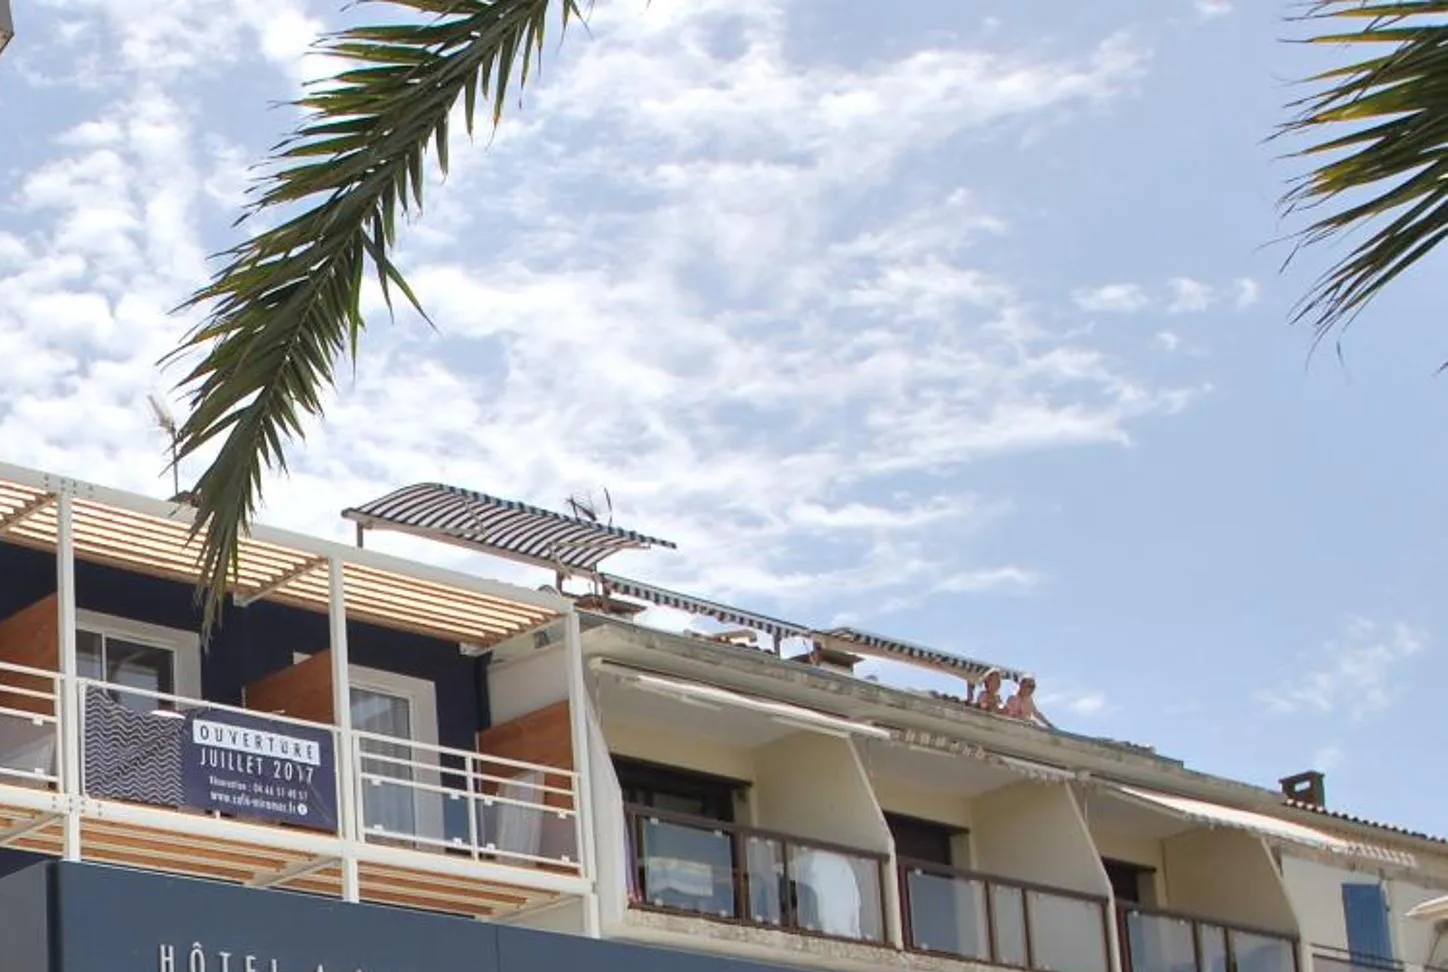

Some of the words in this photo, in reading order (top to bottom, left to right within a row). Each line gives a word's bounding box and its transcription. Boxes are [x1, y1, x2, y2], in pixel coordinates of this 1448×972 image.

[200, 724, 314, 760] OUVERTURE
[200, 747, 263, 776] JUILLET
[273, 760, 314, 784] 2017
